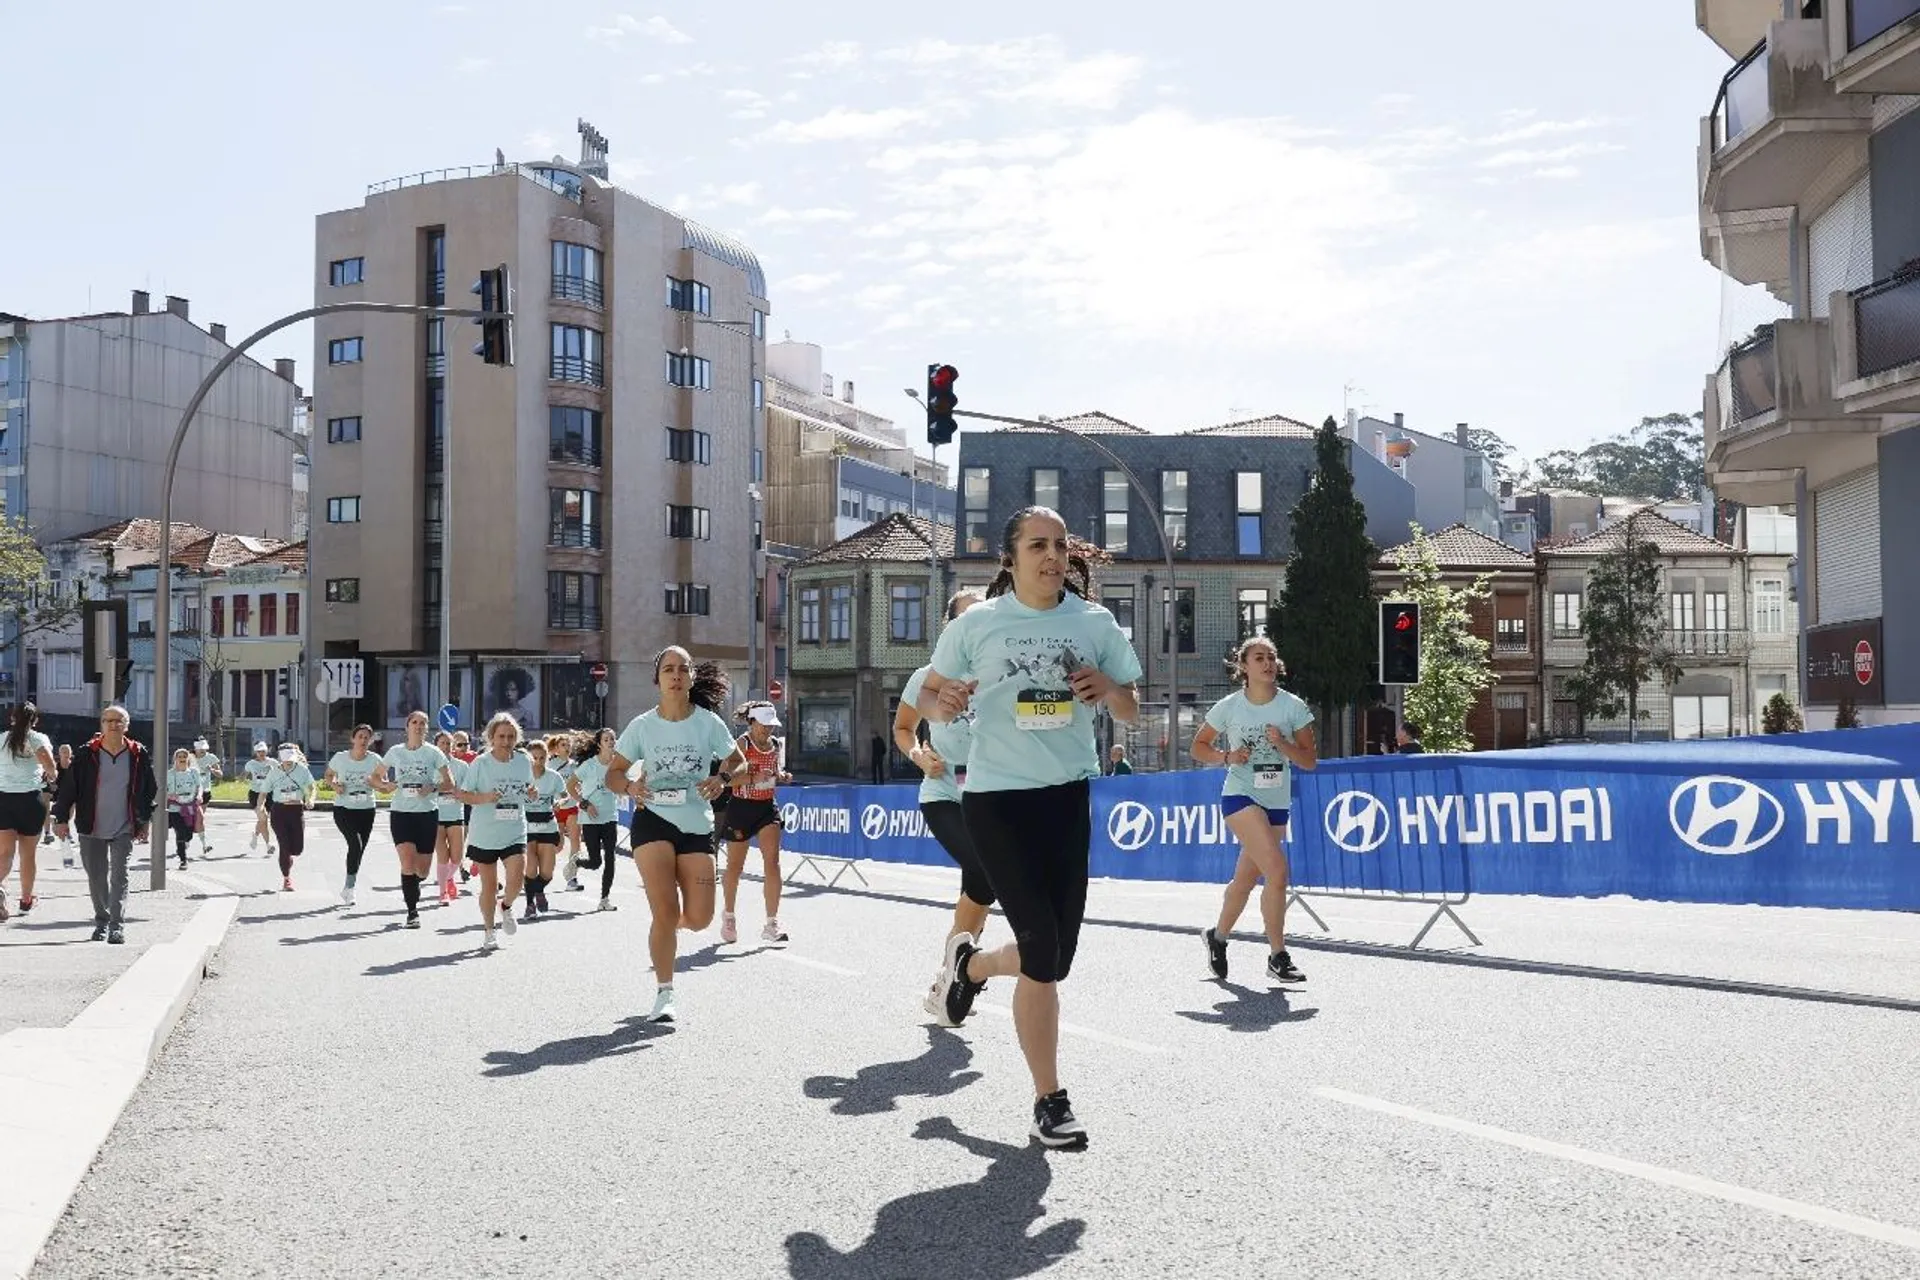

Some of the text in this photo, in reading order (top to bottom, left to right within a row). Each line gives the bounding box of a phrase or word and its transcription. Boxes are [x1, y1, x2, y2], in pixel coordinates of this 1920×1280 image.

[1033, 703, 1056, 715] 150
[801, 807, 850, 834] HYUNDAI
[1398, 787, 1612, 844] HYUNDAI
